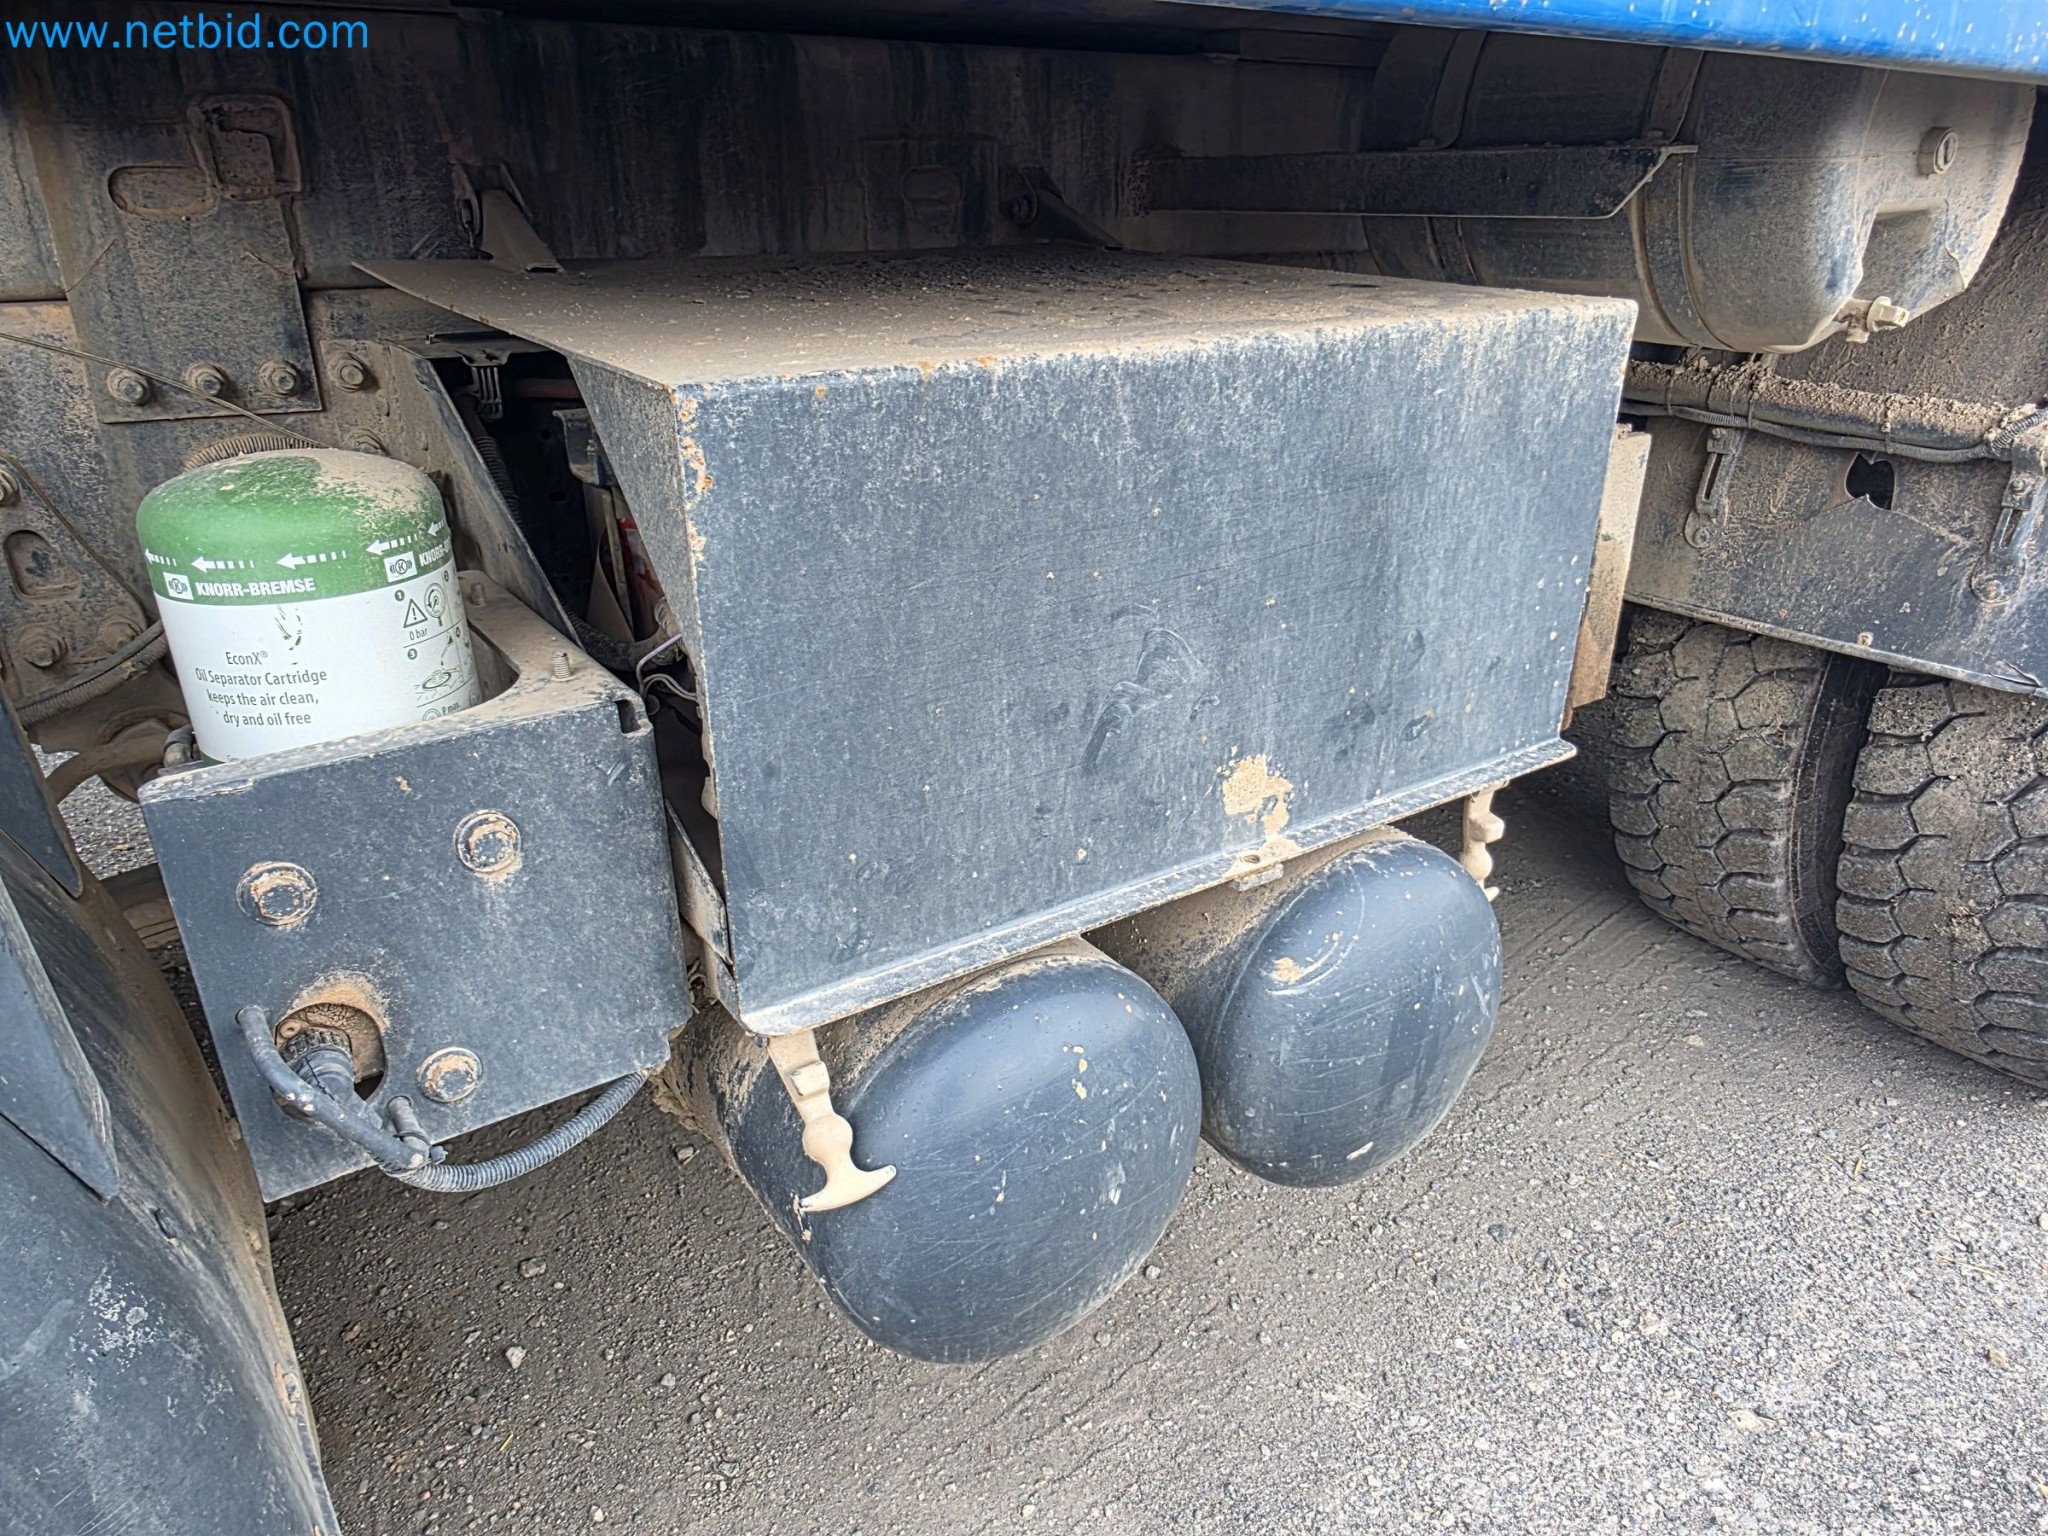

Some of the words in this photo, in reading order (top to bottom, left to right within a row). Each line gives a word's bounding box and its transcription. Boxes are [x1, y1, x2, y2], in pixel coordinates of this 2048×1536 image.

[195, 578, 316, 597] KNORR-BREMSE
[415, 628, 428, 639] bar
[195, 667, 208, 682] Oil
[208, 670, 262, 687] Separator
[265, 669, 327, 686] Cartridge
[206, 688, 236, 707] keeps
[237, 692, 257, 706] the
[260, 693, 276, 706] air
[279, 692, 319, 705] clean,
[223, 711, 240, 727] dry
[242, 713, 264, 726] and
[266, 712, 283, 726] oil
[284, 711, 312, 725] free
